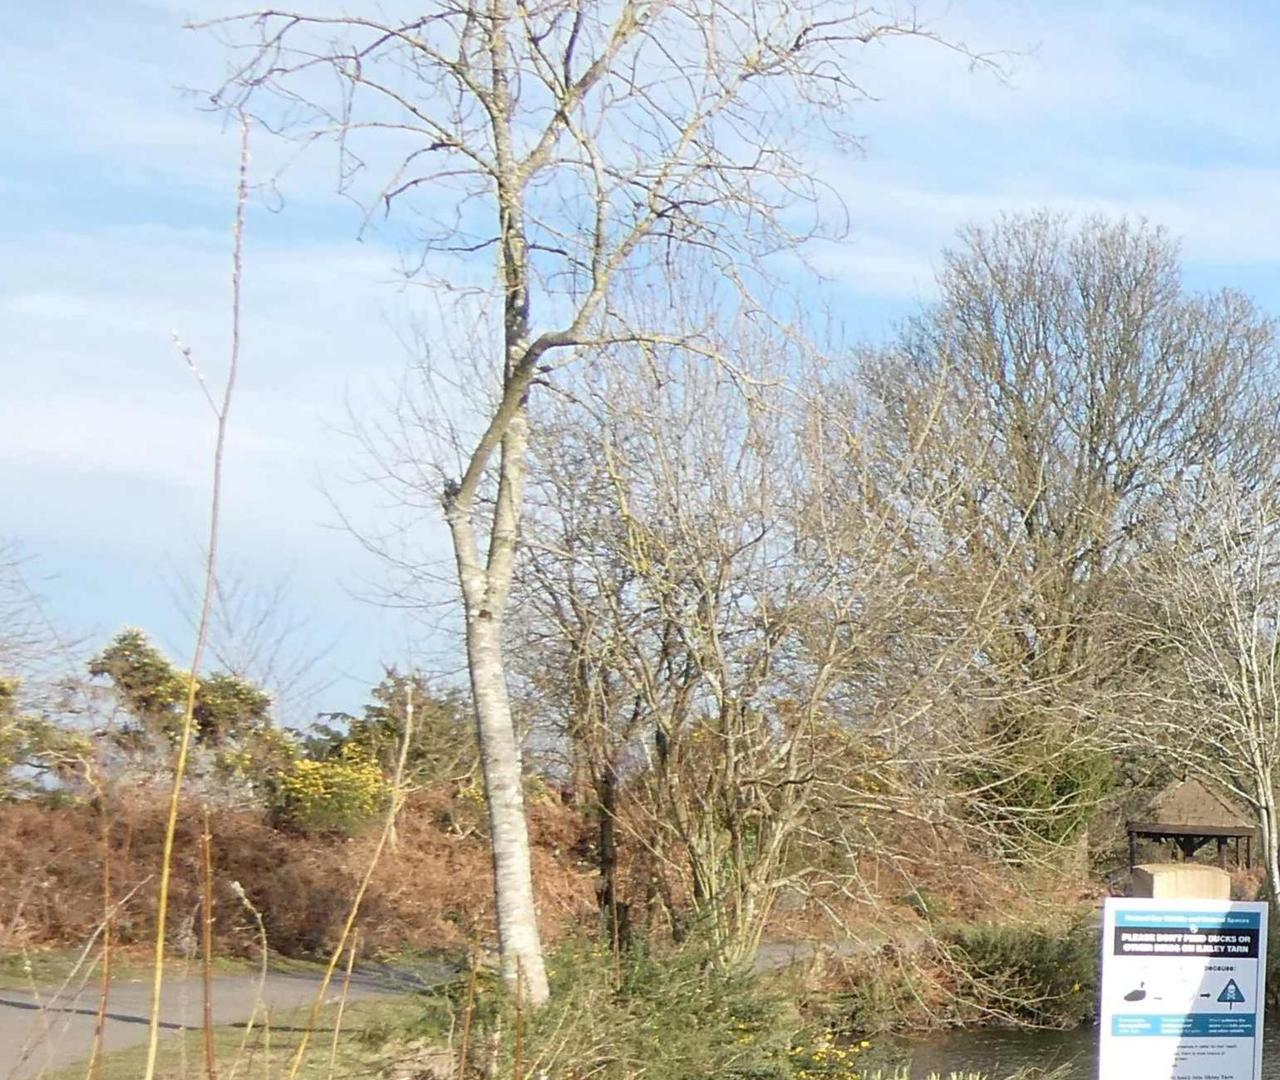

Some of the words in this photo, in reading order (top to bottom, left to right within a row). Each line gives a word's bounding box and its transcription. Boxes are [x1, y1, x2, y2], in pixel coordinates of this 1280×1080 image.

[1121, 933, 1156, 942] PLEASE
[1208, 935, 1237, 943] DUCKS
[1227, 945, 1249, 953] TARN
